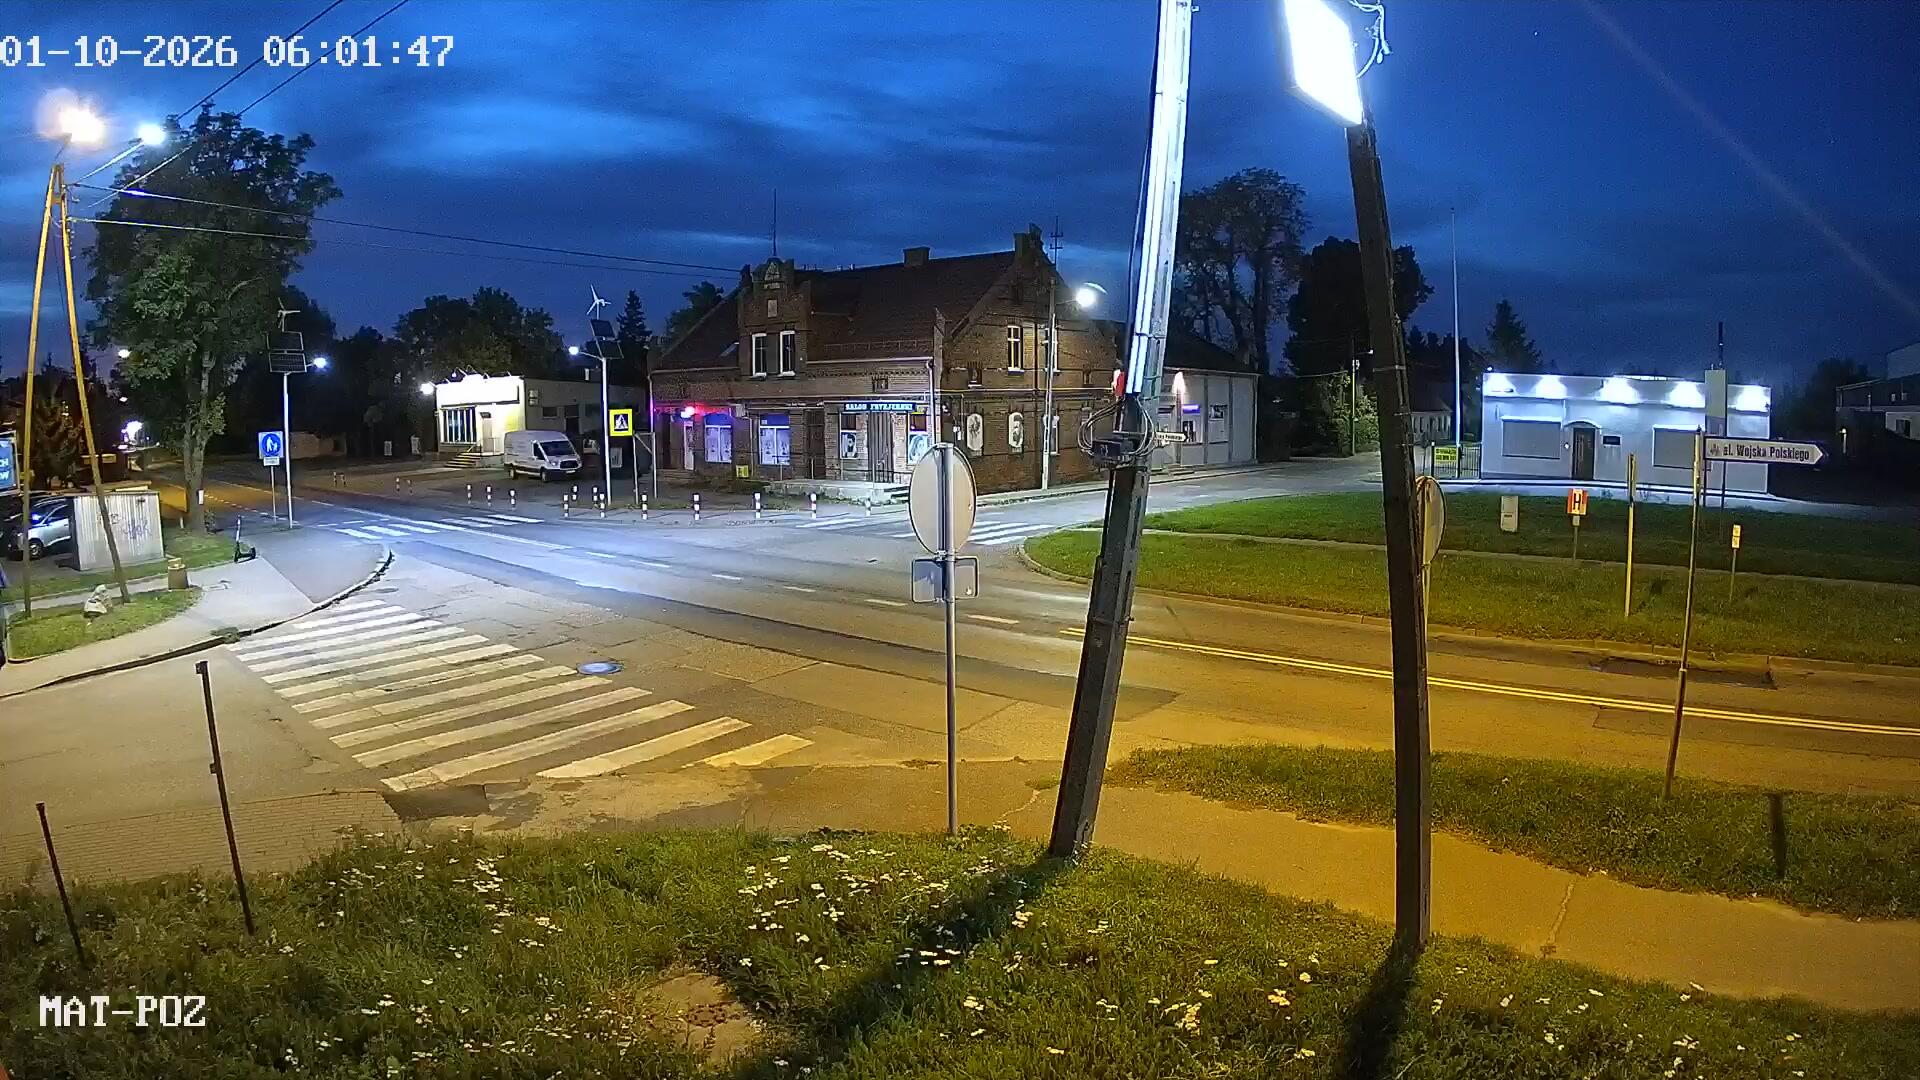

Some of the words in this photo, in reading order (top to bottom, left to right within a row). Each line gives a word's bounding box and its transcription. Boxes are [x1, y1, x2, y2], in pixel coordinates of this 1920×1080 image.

[846, 403, 867, 411] SALON
[1736, 445, 1768, 459] Wojska
[1770, 446, 1810, 462] Polskiego
[1573, 493, 1582, 510] H
